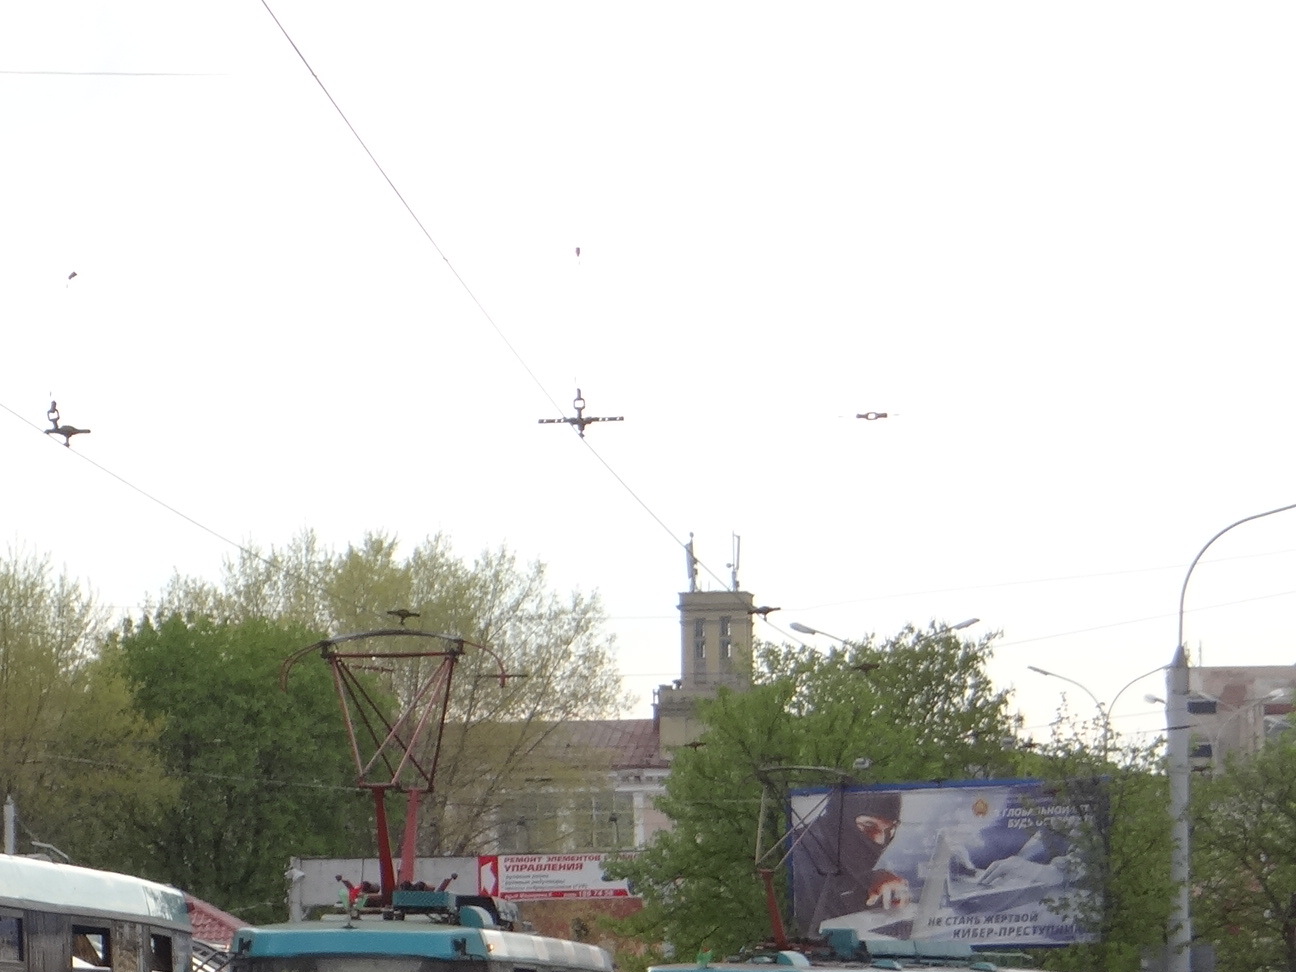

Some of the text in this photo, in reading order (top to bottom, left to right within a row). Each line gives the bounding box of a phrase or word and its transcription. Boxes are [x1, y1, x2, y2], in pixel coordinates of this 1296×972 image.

[504, 862, 584, 873] УПРАВЛЕНИЯ
[945, 915, 980, 926] СТАНЬ
[983, 912, 1039, 925] ЖЕРТВОЙ
